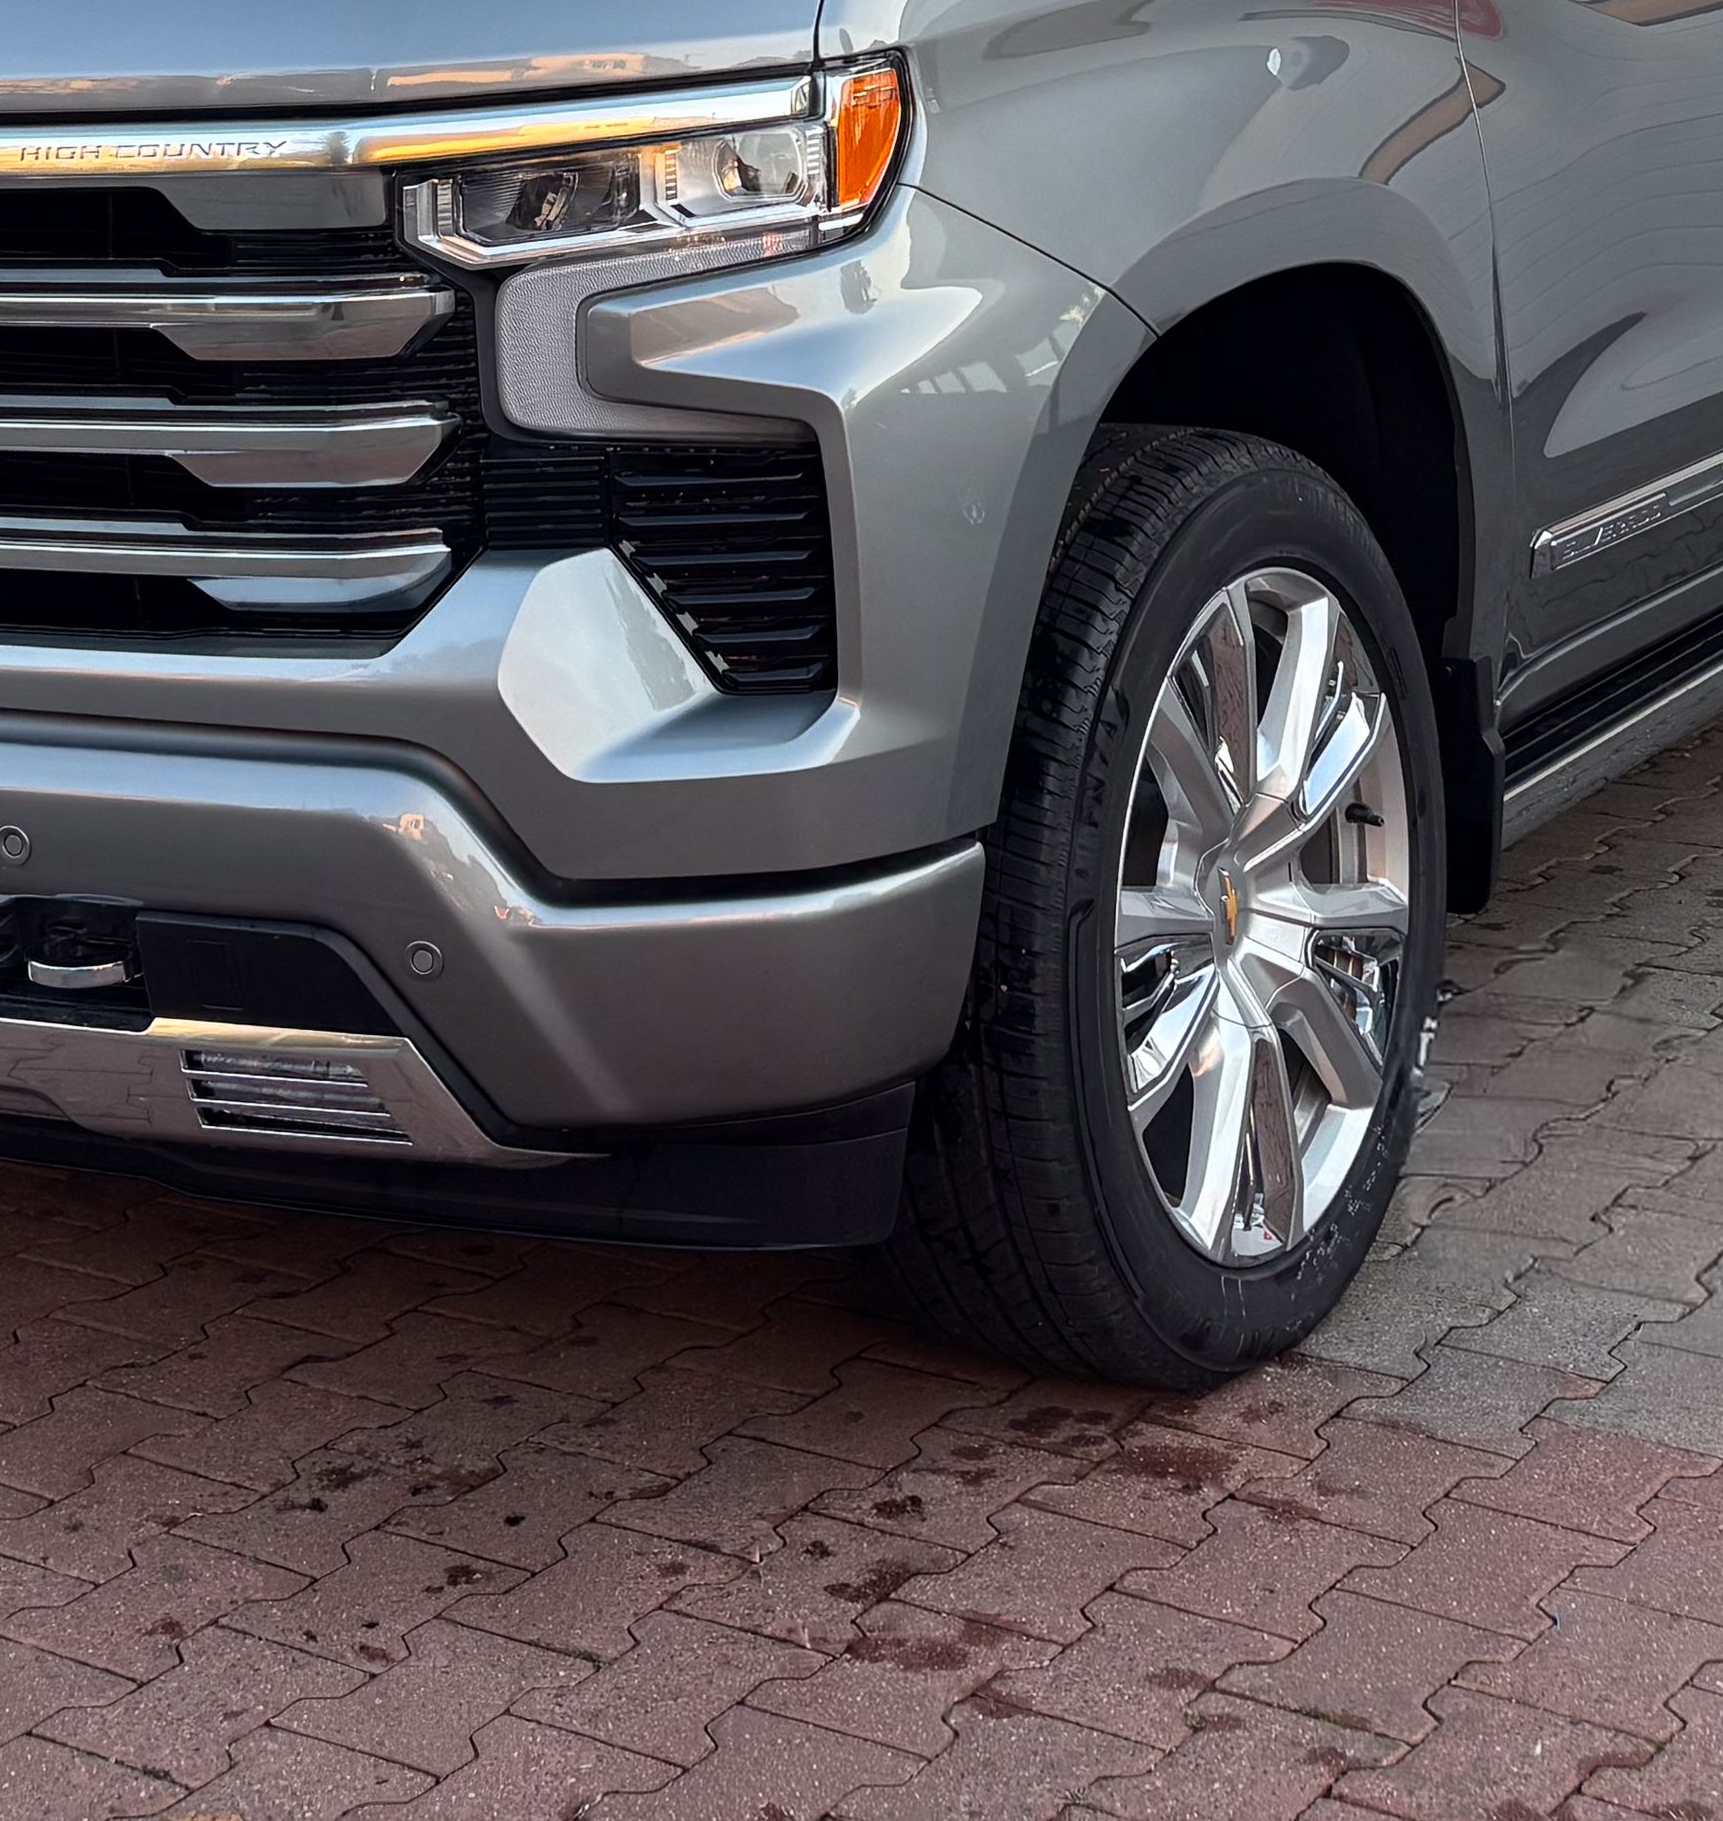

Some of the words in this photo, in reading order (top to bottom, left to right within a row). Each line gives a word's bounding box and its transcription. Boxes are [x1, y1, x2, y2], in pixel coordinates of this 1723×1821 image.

[20, 144, 103, 162] HIGH
[115, 140, 288, 159] COUNTRY
[1561, 504, 1662, 560] SLVERADO
